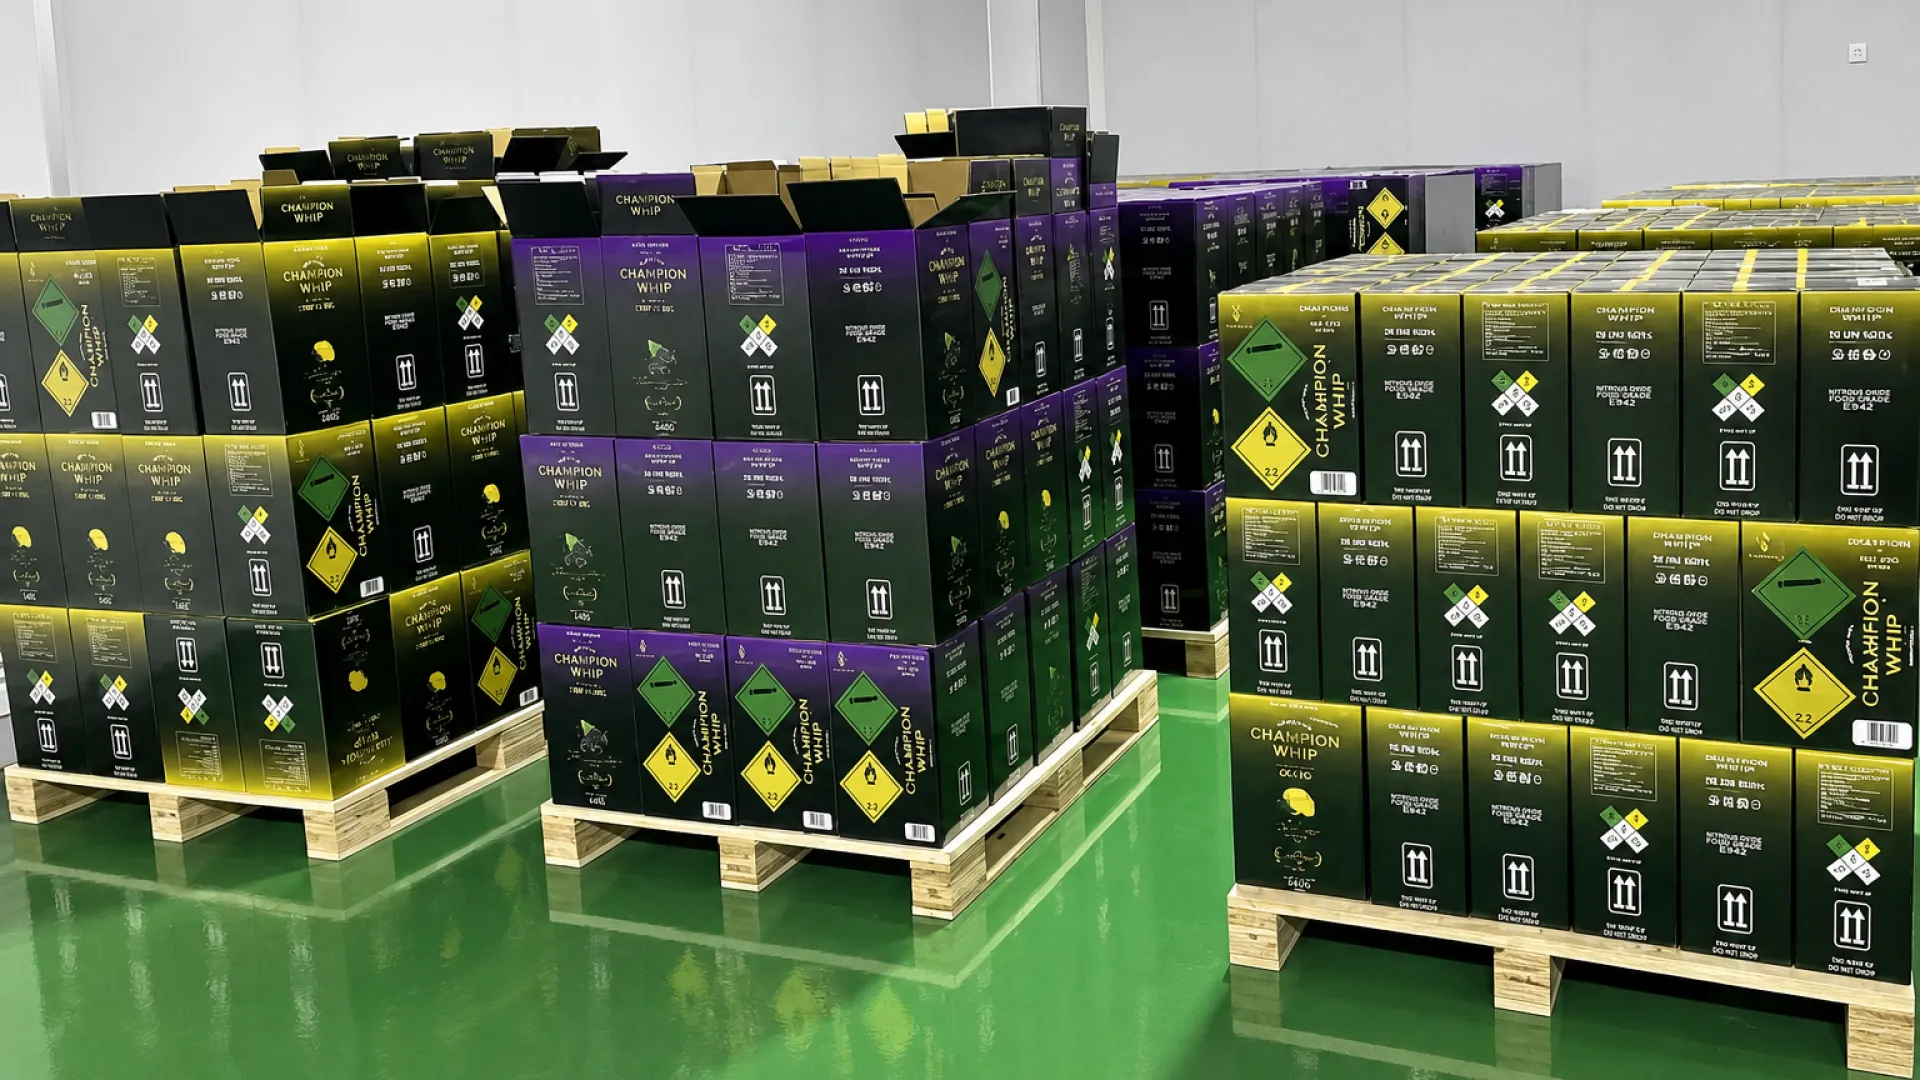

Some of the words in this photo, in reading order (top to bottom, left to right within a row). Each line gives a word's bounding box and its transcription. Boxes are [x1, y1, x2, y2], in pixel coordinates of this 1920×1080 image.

[280, 201, 334, 213] CHAMPION
[615, 194, 675, 205] CHAMPION
[293, 211, 324, 224] WHIP
[630, 205, 661, 216] WHIP
[282, 266, 344, 283] CHAMPION
[619, 268, 688, 281] CHAMPION
[298, 280, 332, 295] WHIP
[636, 281, 673, 295] WHIP
[1313, 344, 1331, 459] CHAMPION
[1331, 373, 1348, 430] WHIP
[460, 418, 506, 437] CHAMPION
[61, 461, 113, 474] CHAMPION
[138, 463, 192, 475] CHAMPION
[538, 465, 603, 478] CHAMPION
[73, 473, 103, 485] WHIP
[150, 475, 182, 487] WHIP
[553, 477, 588, 491] WHIP
[1862, 580, 1880, 708] CHAMPION
[1886, 614, 1904, 676] WHIP
[554, 653, 618, 669] CHAMPION
[570, 665, 604, 681] WHIP
[698, 691, 715, 776] CHAMPION
[711, 713, 724, 757] WHIP
[1250, 728, 1340, 750] CHAMPION
[799, 699, 815, 785] CHAMPION
[812, 722, 825, 765] WHIP
[900, 706, 918, 796] CHAMPION
[915, 730, 928, 774] WHIP
[1272, 745, 1319, 762] WHIP
